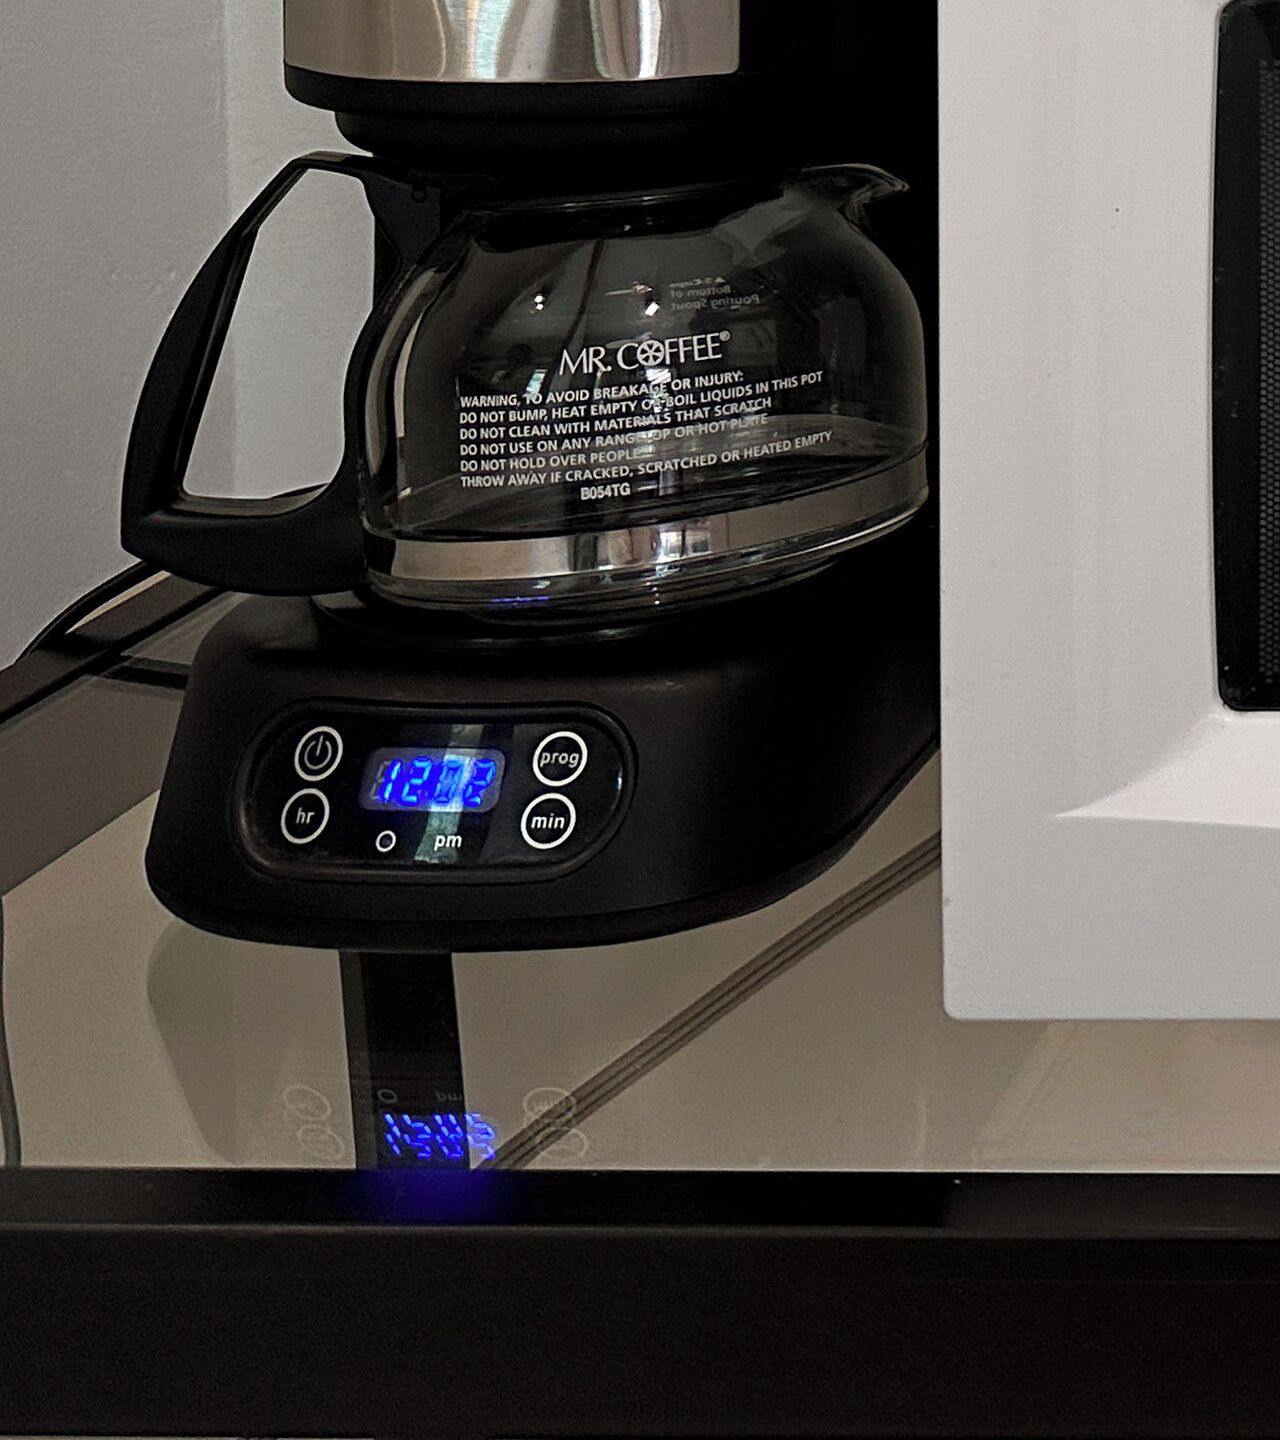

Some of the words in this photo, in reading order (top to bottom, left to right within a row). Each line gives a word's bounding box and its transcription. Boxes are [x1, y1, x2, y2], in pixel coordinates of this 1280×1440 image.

[559, 346, 612, 376] MR.
[460, 394, 521, 409] WARNING,
[525, 394, 542, 405] TO
[546, 389, 590, 403] AVOID
[671, 377, 691, 391] OR
[695, 370, 744, 387] INJURY:
[460, 412, 477, 424] DO
[480, 411, 504, 423] NOT
[509, 408, 548, 422] BUMP,
[552, 406, 587, 419] HEAT
[591, 400, 638, 417] EMPTY
[666, 393, 697, 408] BOIL
[701, 385, 752, 403] LIQUIDS
[756, 382, 769, 394] IN
[772, 376, 798, 391] THIS
[801, 371, 823, 385] POT
[460, 428, 477, 440] DO
[480, 427, 506, 439] NOT
[509, 424, 550, 438] CLEAN
[553, 421, 590, 435] WITH
[594, 412, 671, 432] MATERIALS
[675, 407, 711, 422] THAT
[715, 397, 772, 416] SCRATCH
[460, 444, 477, 456] DO
[480, 443, 506, 454] NOT
[509, 441, 533, 453] USE
[537, 440, 558, 452] ON
[561, 437, 591, 450] ANY
[674, 425, 694, 438] OR
[699, 421, 726, 435] HOT
[460, 475, 505, 488] THROW
[508, 472, 547, 486] AWAY
[550, 471, 562, 483] IF
[565, 465, 634, 482] CRACKED,
[637, 453, 717, 474] SCRATCHED
[721, 449, 740, 463] OR
[744, 440, 792, 459] HEATED
[795, 431, 832, 449] EMPTY
[460, 460, 477, 472] DO
[480, 459, 507, 470] NOT
[509, 456, 546, 469] HOLD
[550, 453, 586, 467] OVER
[540, 752, 580, 767] prog
[296, 807, 315, 824] hr
[531, 813, 565, 829] min
[433, 834, 462, 851] pm
